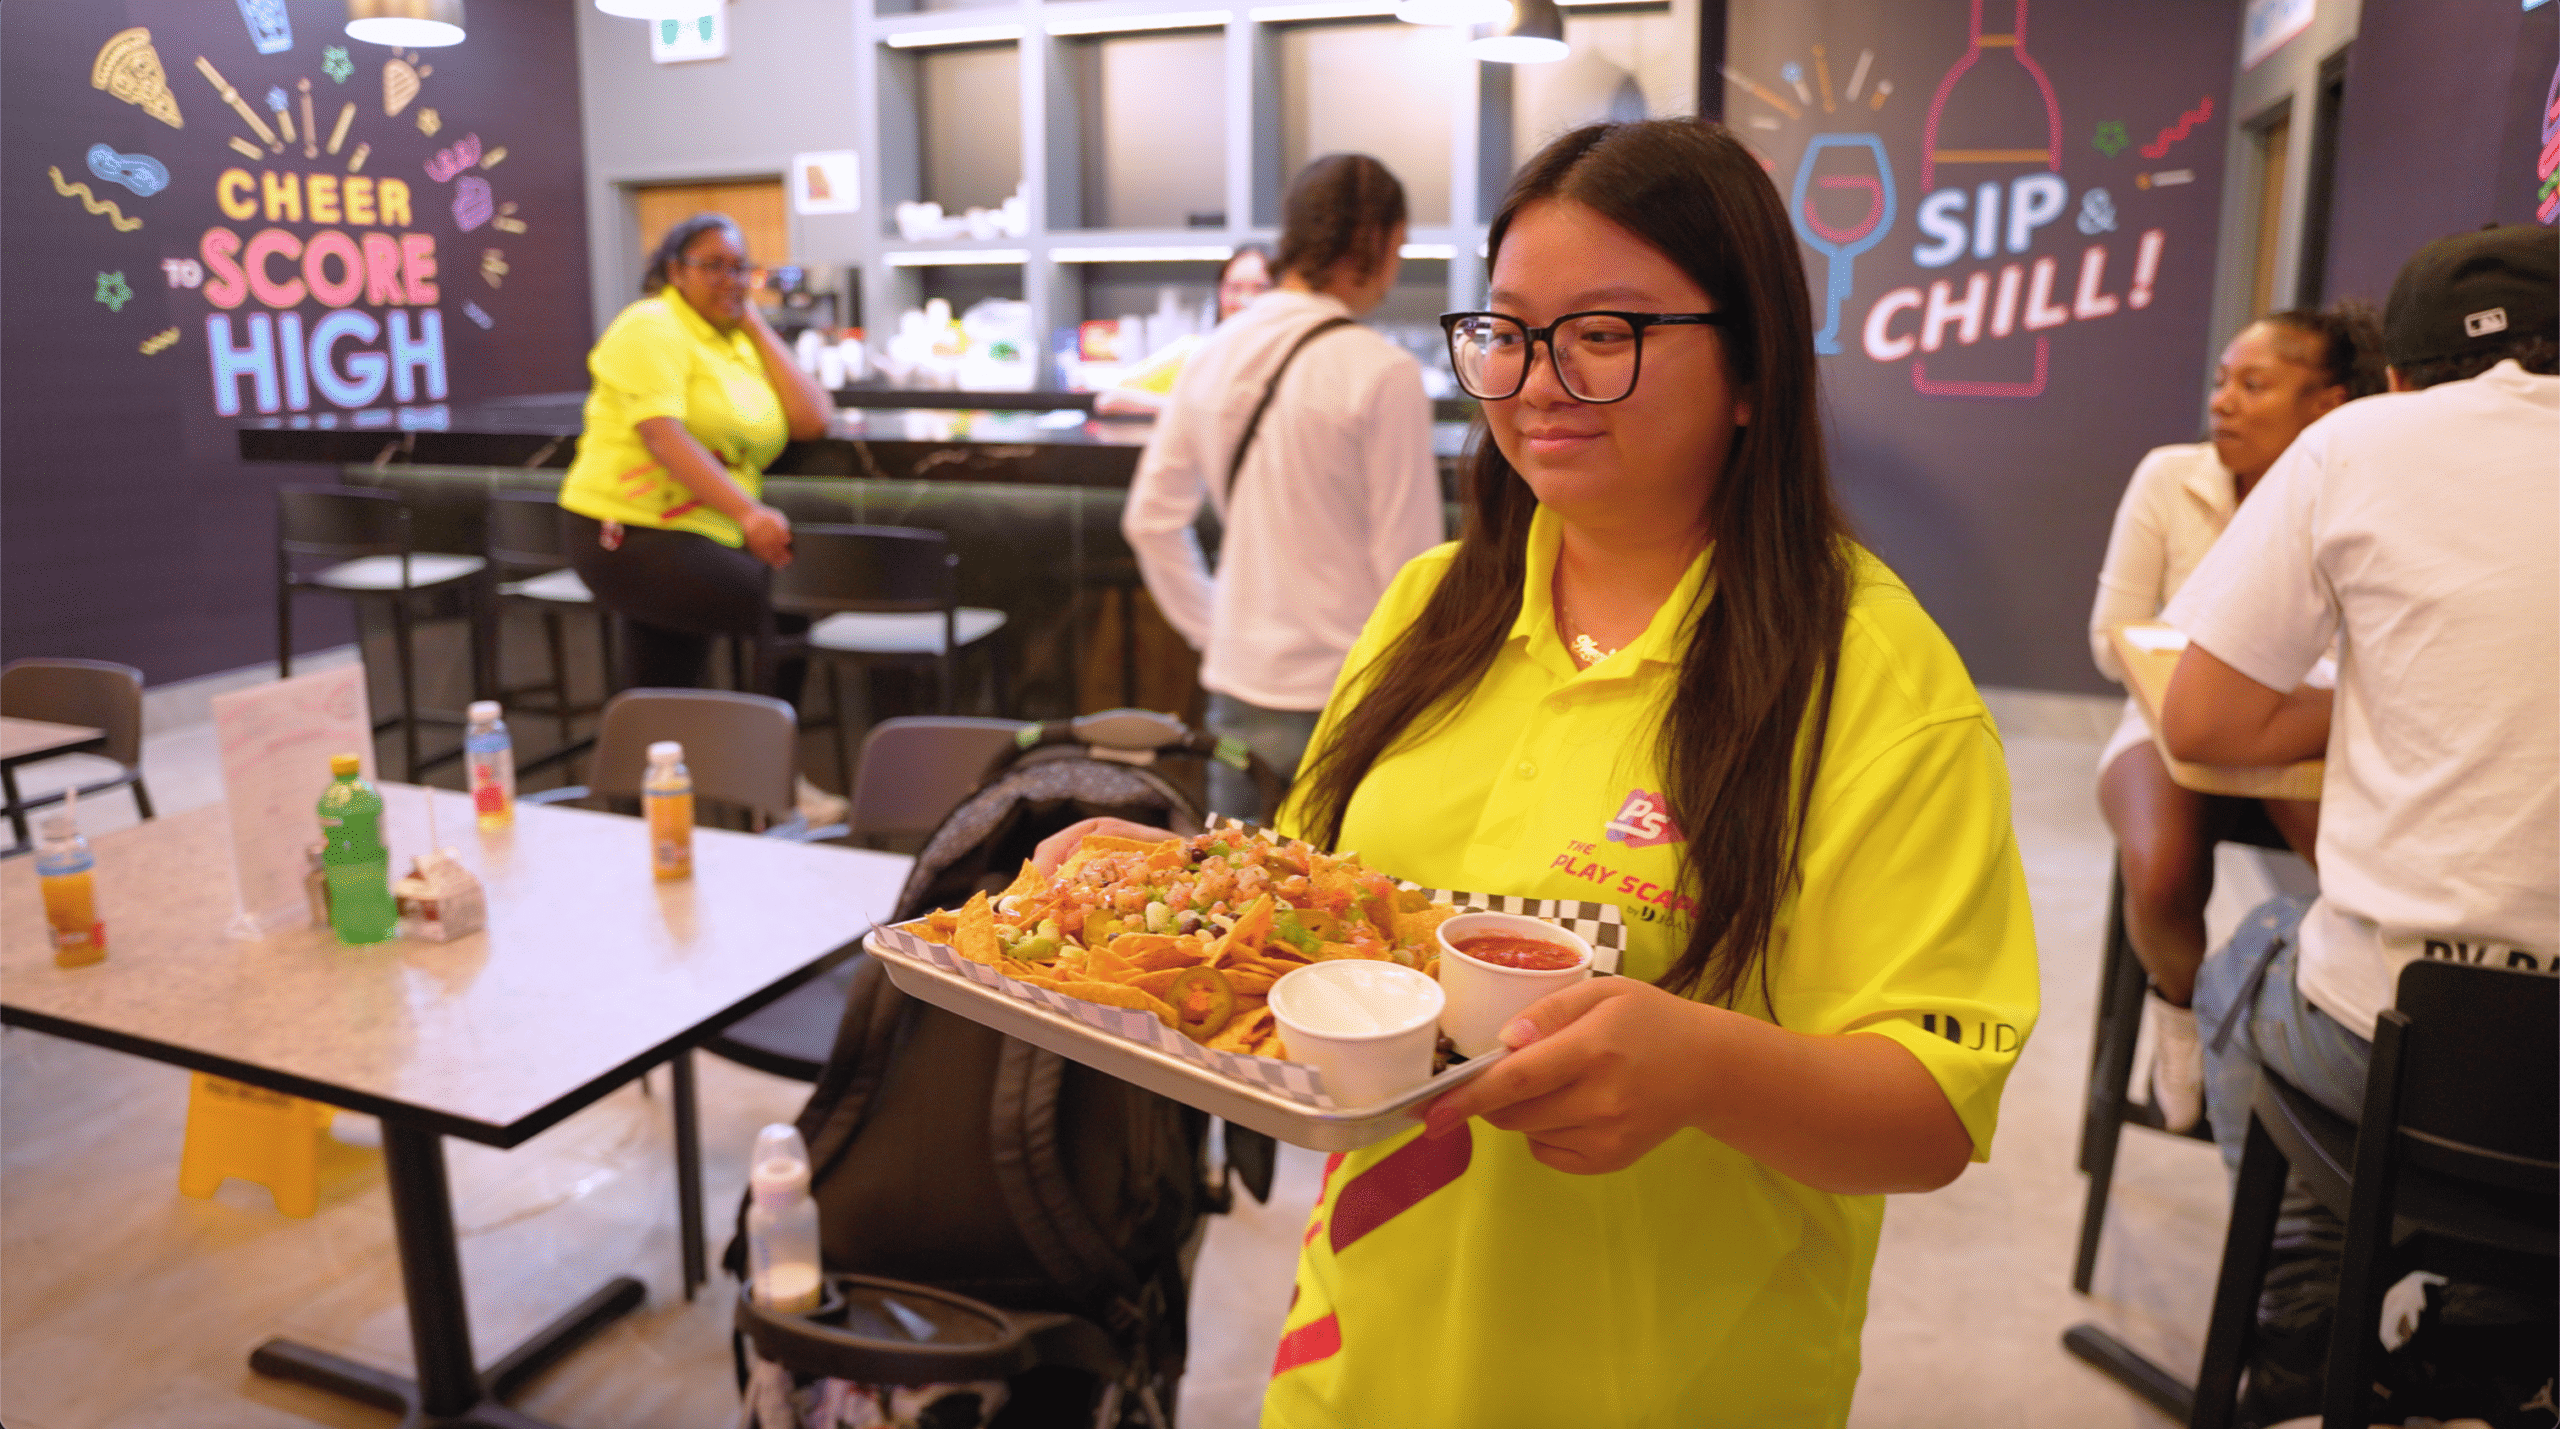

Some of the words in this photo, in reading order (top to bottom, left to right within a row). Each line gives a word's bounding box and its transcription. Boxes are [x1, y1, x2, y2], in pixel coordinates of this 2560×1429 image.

[216, 167, 412, 227] CHEER
[1912, 172, 2068, 268] SIP
[2076, 187, 2118, 235] &
[161, 257, 204, 289] TO
[201, 226, 441, 309] SCORE
[1861, 227, 2166, 362] CHILL!
[206, 308, 449, 417] HIGH
[1566, 839, 1598, 856] THE
[1604, 798, 1671, 840] PS
[1550, 853, 1618, 885] PLAY
